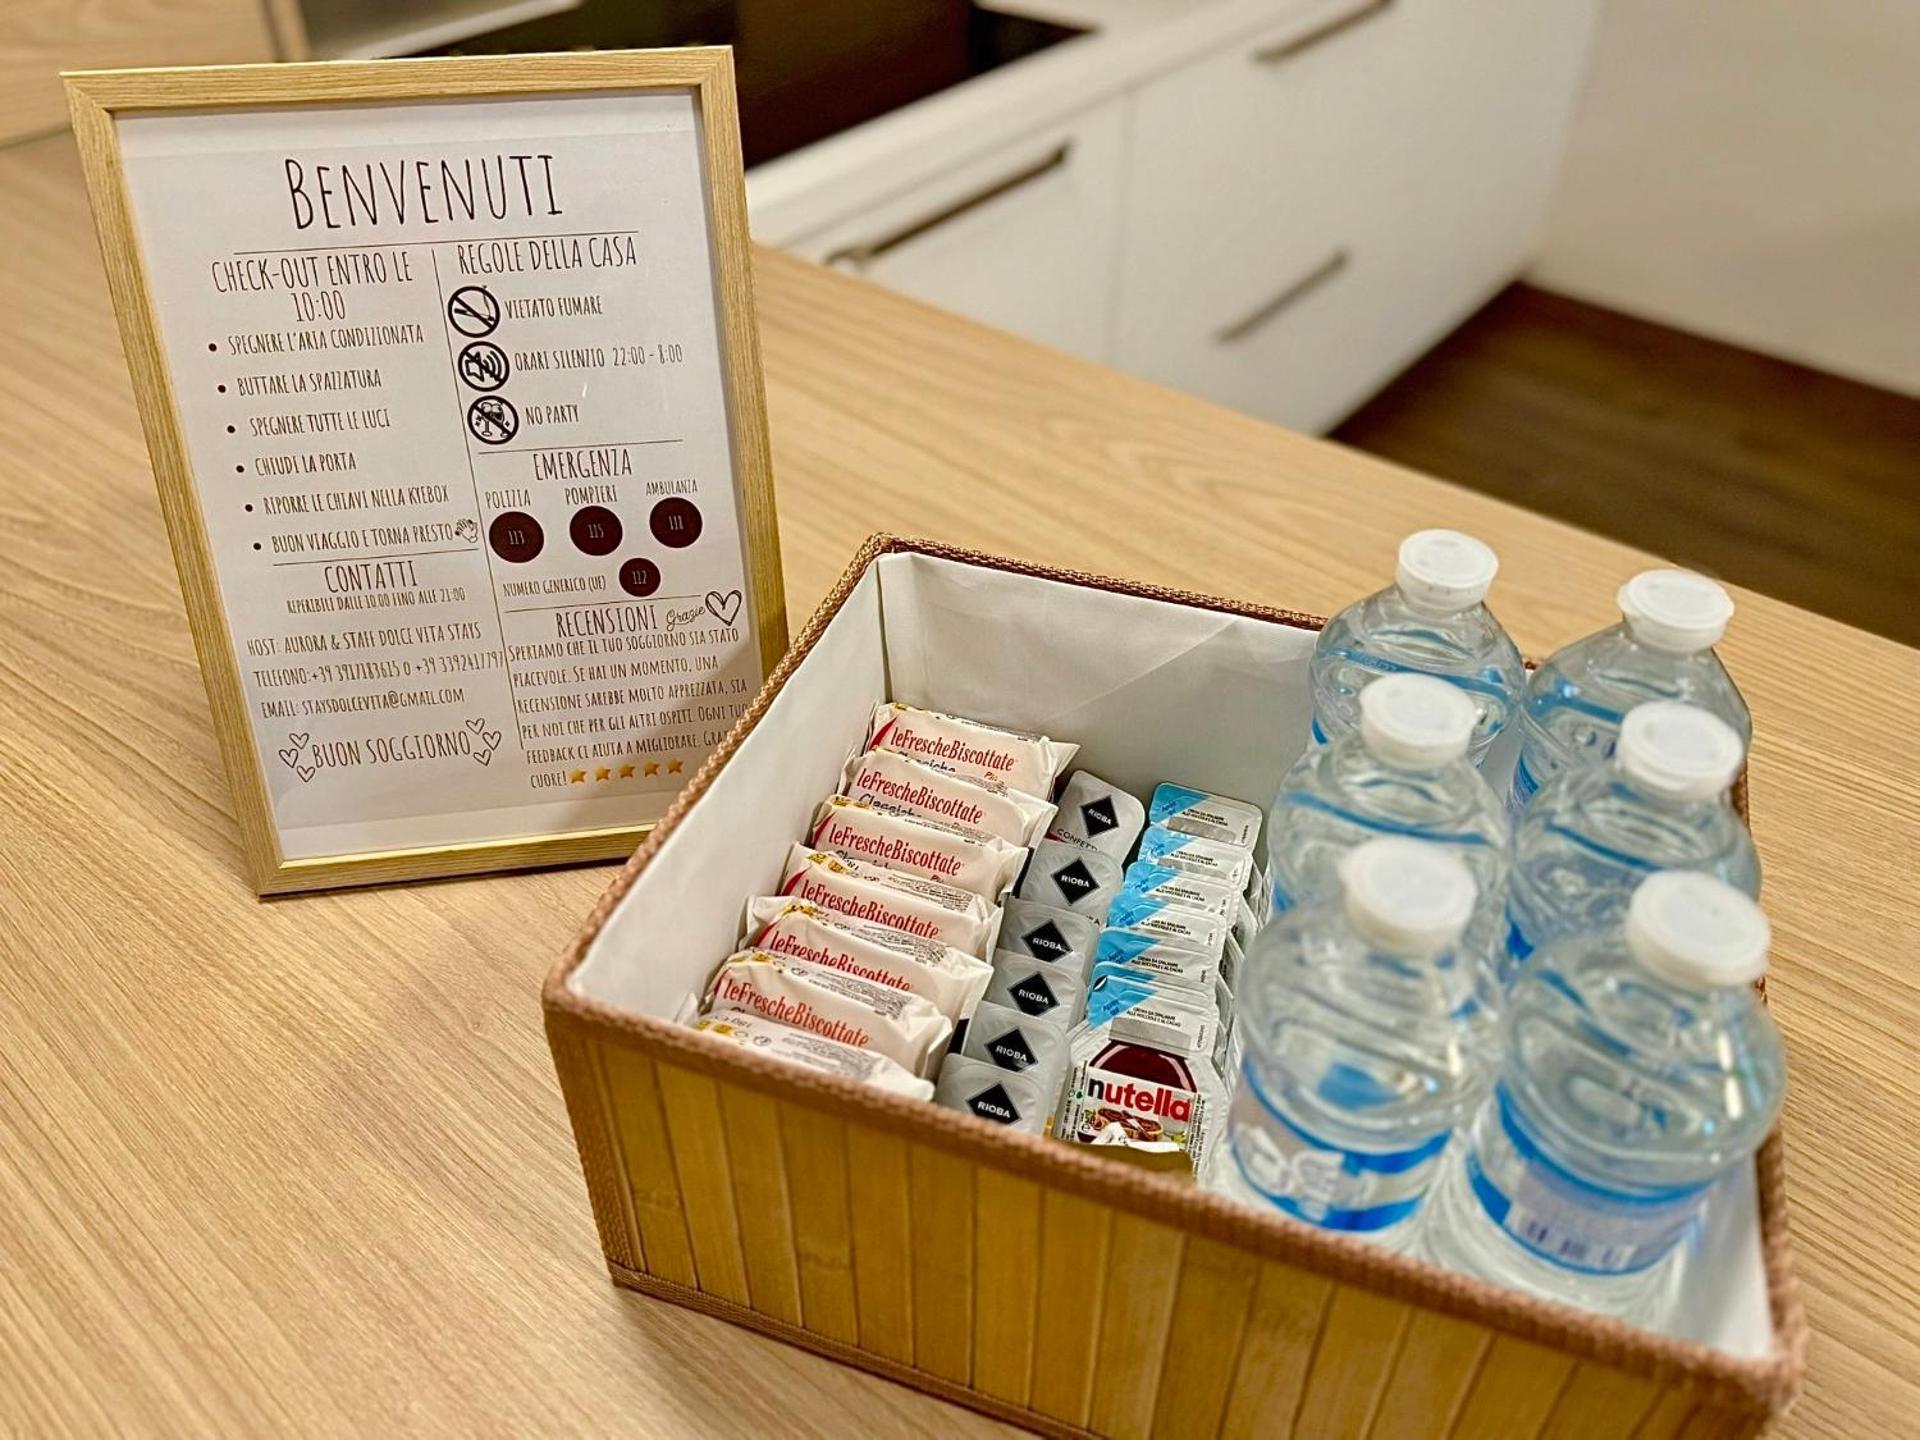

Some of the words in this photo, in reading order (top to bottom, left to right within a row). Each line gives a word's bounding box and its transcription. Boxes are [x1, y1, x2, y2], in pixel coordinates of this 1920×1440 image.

[285, 154, 563, 229] BENVENUTI
[457, 241, 524, 275] REGOLE
[529, 238, 583, 271] DELLA
[588, 236, 637, 268] CASA
[211, 256, 319, 292] CHECK-OUT
[327, 252, 387, 286] ENTRO
[393, 251, 413, 282] LE
[290, 290, 346, 322] 10:00
[504, 297, 554, 319] VIETATO
[558, 295, 603, 316] FUMARE
[228, 332, 284, 356] SPEGNERE
[287, 329, 328, 352] L'ARIA
[330, 324, 424, 349] CONDIZIONATA
[514, 352, 550, 371] ORARI
[553, 348, 605, 370] SILENZIO
[612, 346, 645, 367] 22:00
[658, 344, 683, 364] 8:00
[237, 374, 289, 397] BUTTARE
[292, 373, 307, 393] LA
[309, 369, 382, 393] SPAZZATURA
[249, 415, 305, 437] SPEGNERE
[307, 412, 345, 433] TUTTE
[346, 411, 359, 430] LE
[361, 408, 391, 429] LUCI
[525, 406, 544, 426] NO
[547, 404, 580, 424] PARTY
[255, 456, 300, 476] CHIUDI
[302, 454, 317, 473] LA
[319, 452, 357, 472] PORTA
[533, 448, 633, 481] EMERGENZA
[263, 495, 309, 515] RIPORRE
[311, 493, 325, 512] LE
[326, 490, 369, 511] CHIAVI
[371, 487, 406, 508] NELLA
[485, 489, 531, 509] POLIZIA
[564, 484, 618, 505] POMPIERI
[645, 479, 698, 496] AMBULANZA
[272, 534, 305, 554] BUON
[306, 530, 359, 551] VIAGGIO
[362, 528, 370, 547] E
[371, 526, 410, 545] TORNA
[412, 523, 454, 543] PRESTO
[324, 560, 418, 593] CONTATTI
[503, 580, 541, 597] NUMERO
[543, 577, 586, 595] GENERICO
[588, 575, 607, 593] (UE)
[286, 597, 335, 614] REPERIBILI
[337, 595, 363, 611] DALLE
[391, 591, 416, 607] FINO
[418, 589, 438, 605] ALLE
[556, 604, 658, 639] RECENSIONI
[666, 605, 706, 632] Grazie
[284, 634, 328, 654] AURORA
[331, 634, 341, 650] &
[342, 630, 375, 650] STAFF
[378, 627, 413, 647] DOLCE
[415, 625, 446, 644] VITA
[447, 621, 482, 641] STAYS
[508, 642, 564, 662] SPERIAMO
[566, 640, 586, 656] CHE
[589, 640, 599, 655] IL
[602, 637, 623, 653] TUO
[626, 632, 686, 651] SOGGIORNO
[689, 631, 706, 646] SIA
[708, 628, 740, 644] STATO
[588, 664, 607, 680] HAI
[610, 663, 628, 679] UN
[695, 656, 719, 672] UNA
[517, 694, 583, 714] RECENSIONE
[584, 690, 625, 708] SAREBBE
[628, 685, 665, 703] MOLTO
[730, 679, 748, 694] SIA
[521, 723, 540, 740] PER
[542, 722, 565, 737] NOI
[567, 719, 585, 735] CHE
[588, 718, 605, 733] PER
[608, 715, 625, 731] GLI
[629, 712, 657, 729] ALTRI
[312, 739, 361, 769] BUON
[366, 730, 472, 765] SOGGIORNO
[526, 748, 576, 764] FEEDBACK
[578, 745, 589, 759] CI
[592, 742, 623, 758] AIUTA
[626, 741, 634, 754] A
[890, 727, 1016, 772] leFrescheBiscottate
[530, 769, 568, 789] CUORE!
[856, 768, 983, 825] leFrescheBiscottate
[1087, 807, 1112, 826] RIOBA
[828, 823, 962, 877] leFrescheBiscottate
[1060, 874, 1090, 888] RIOBA
[1032, 936, 1063, 951] RIOBA
[1018, 989, 1049, 1005] RIOBA
[995, 1045, 1027, 1062] RIOBA
[977, 1100, 1011, 1119] RIOBA
[1087, 1077, 1191, 1122] nutella
